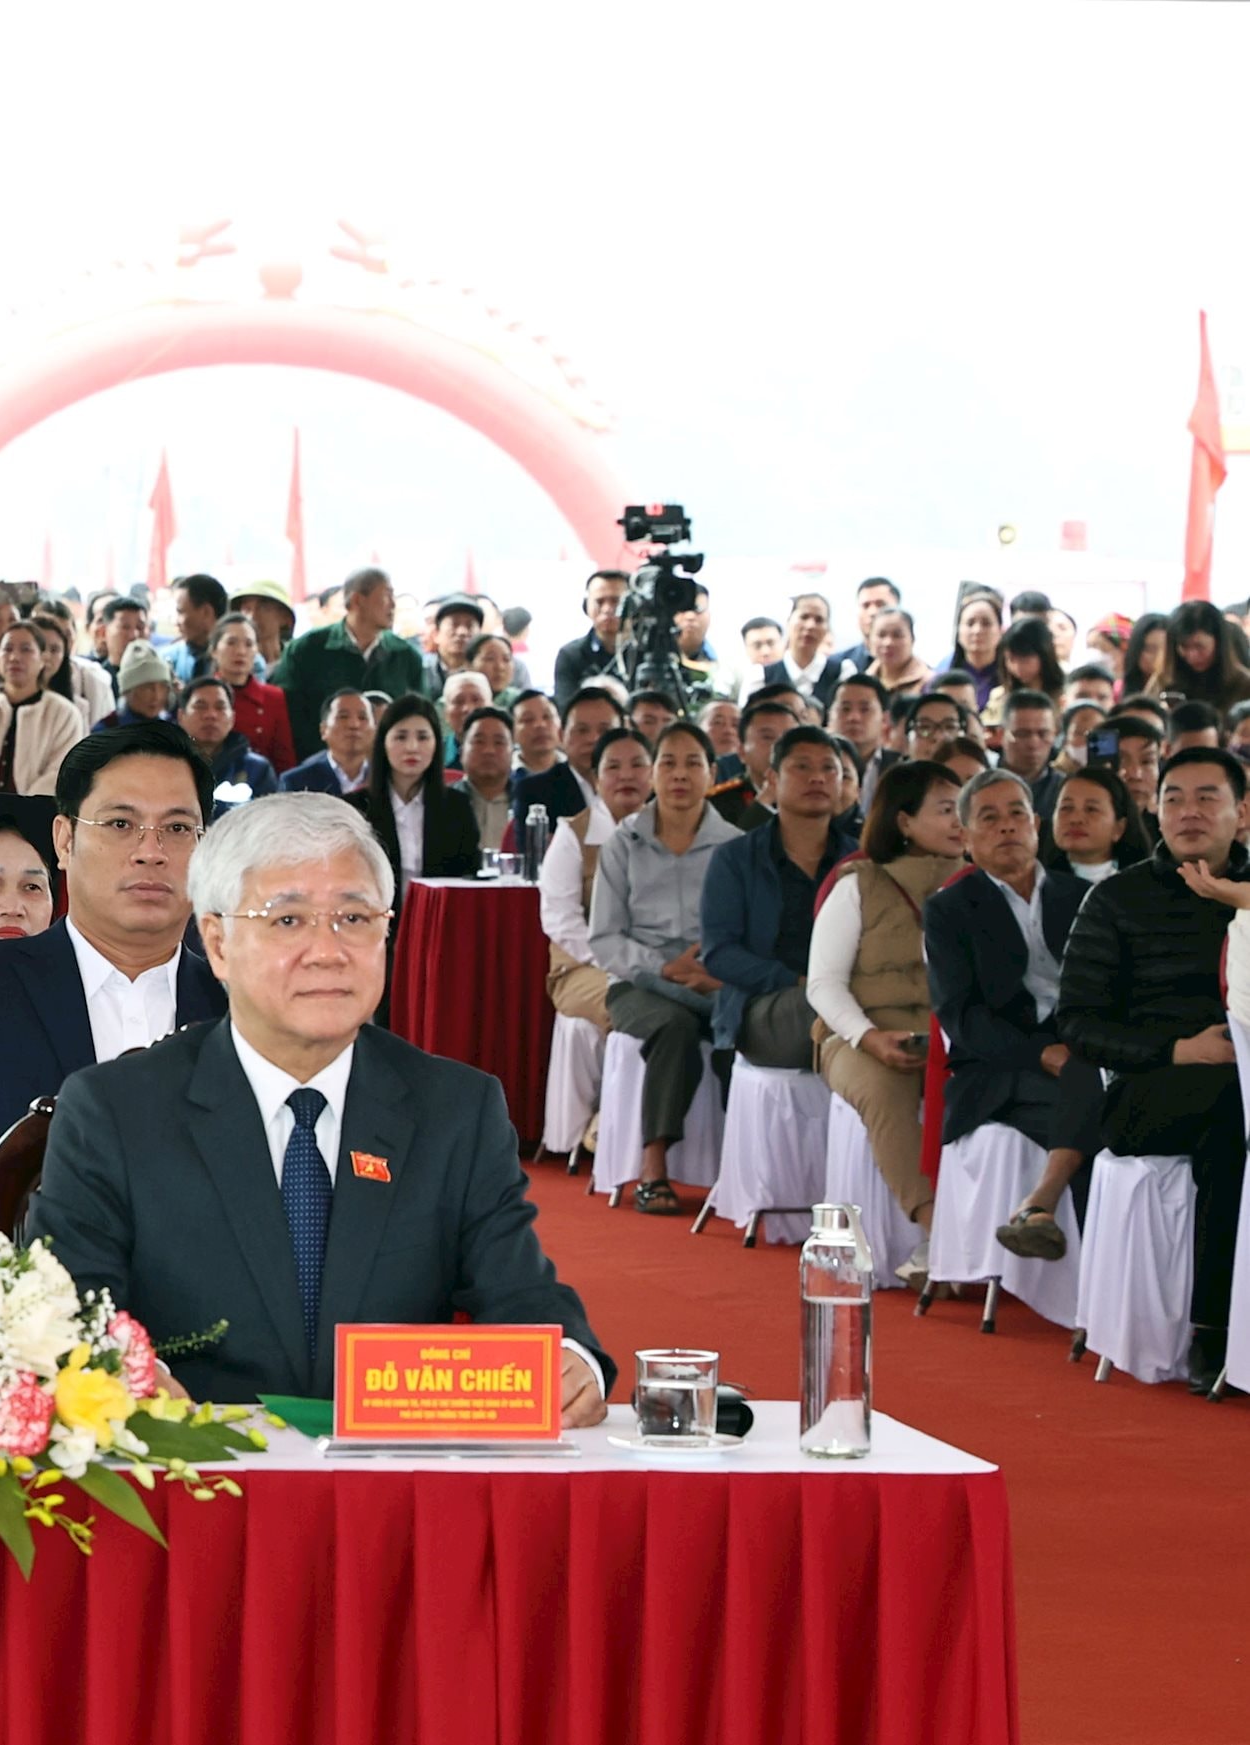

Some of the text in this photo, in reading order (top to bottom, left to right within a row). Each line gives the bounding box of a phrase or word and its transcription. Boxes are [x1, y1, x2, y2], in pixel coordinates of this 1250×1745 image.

[365, 1360, 532, 1392] ĐỖ VĂN CHIẾN
